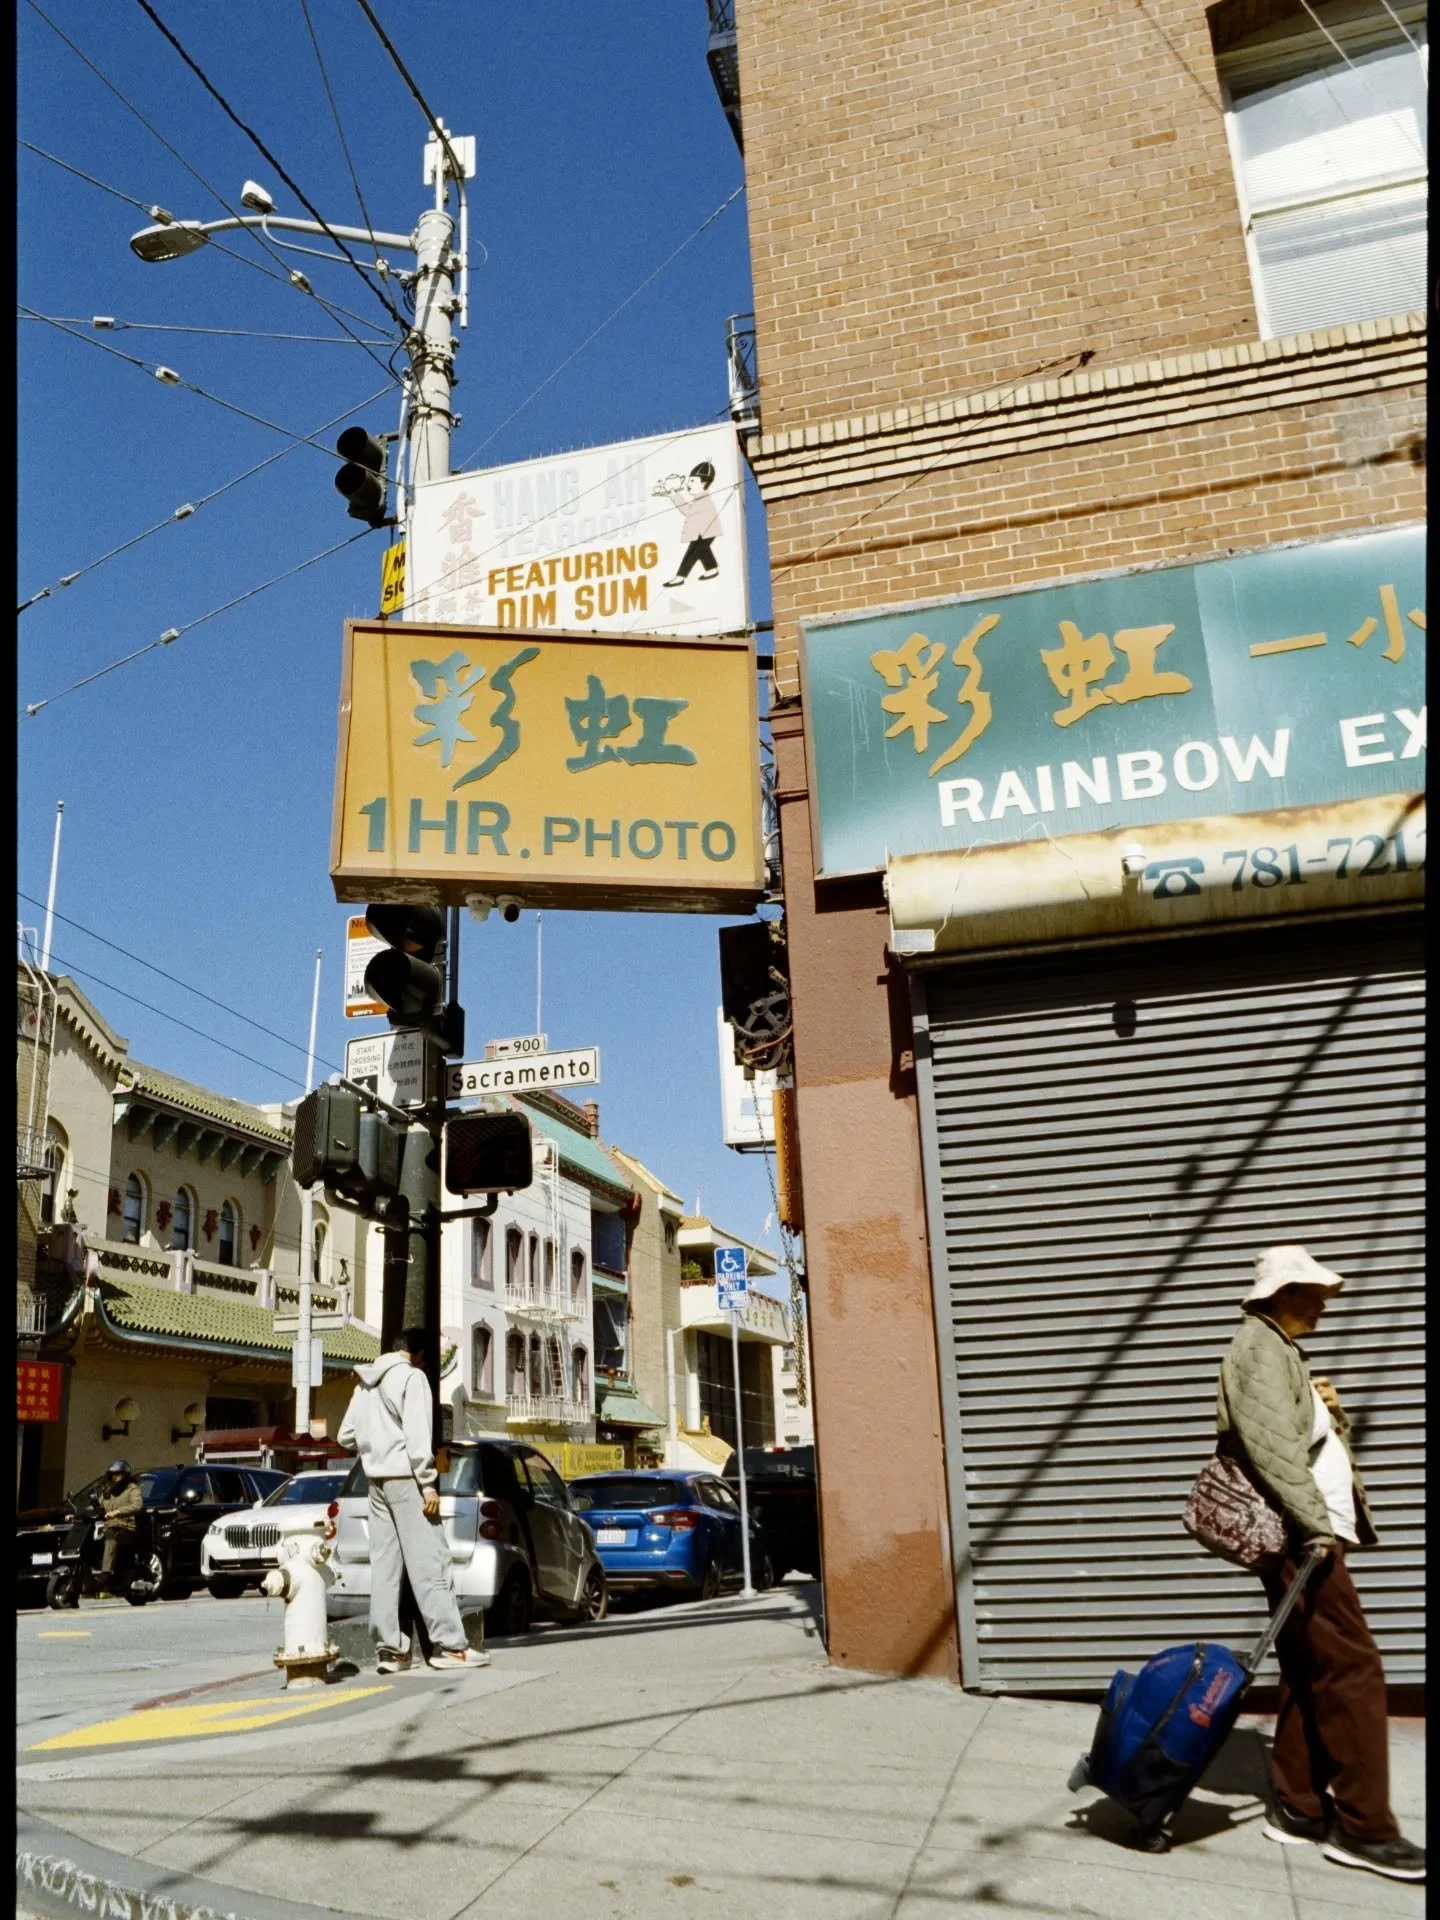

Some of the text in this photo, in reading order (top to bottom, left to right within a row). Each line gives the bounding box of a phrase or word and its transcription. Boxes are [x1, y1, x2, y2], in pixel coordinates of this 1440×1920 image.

[493, 454, 648, 529] HANG AH
[487, 541, 659, 597] FEATURING
[496, 589, 557, 628] DIM
[574, 574, 648, 621] SUM
[409, 646, 698, 793] 彩虹
[937, 728, 1291, 828] RAINBOW
[358, 796, 737, 862] 1 HR. PHOTO
[1222, 831, 1427, 892] 781-721
[350, 1054, 382, 1066] CROSSING
[351, 1066, 368, 1076] ONLY
[368, 1064, 379, 1073] ON
[356, 1045, 376, 1055] START
[513, 1037, 541, 1053] 900
[451, 1058, 590, 1092] Sacramento
[717, 1271, 745, 1282] PARKING
